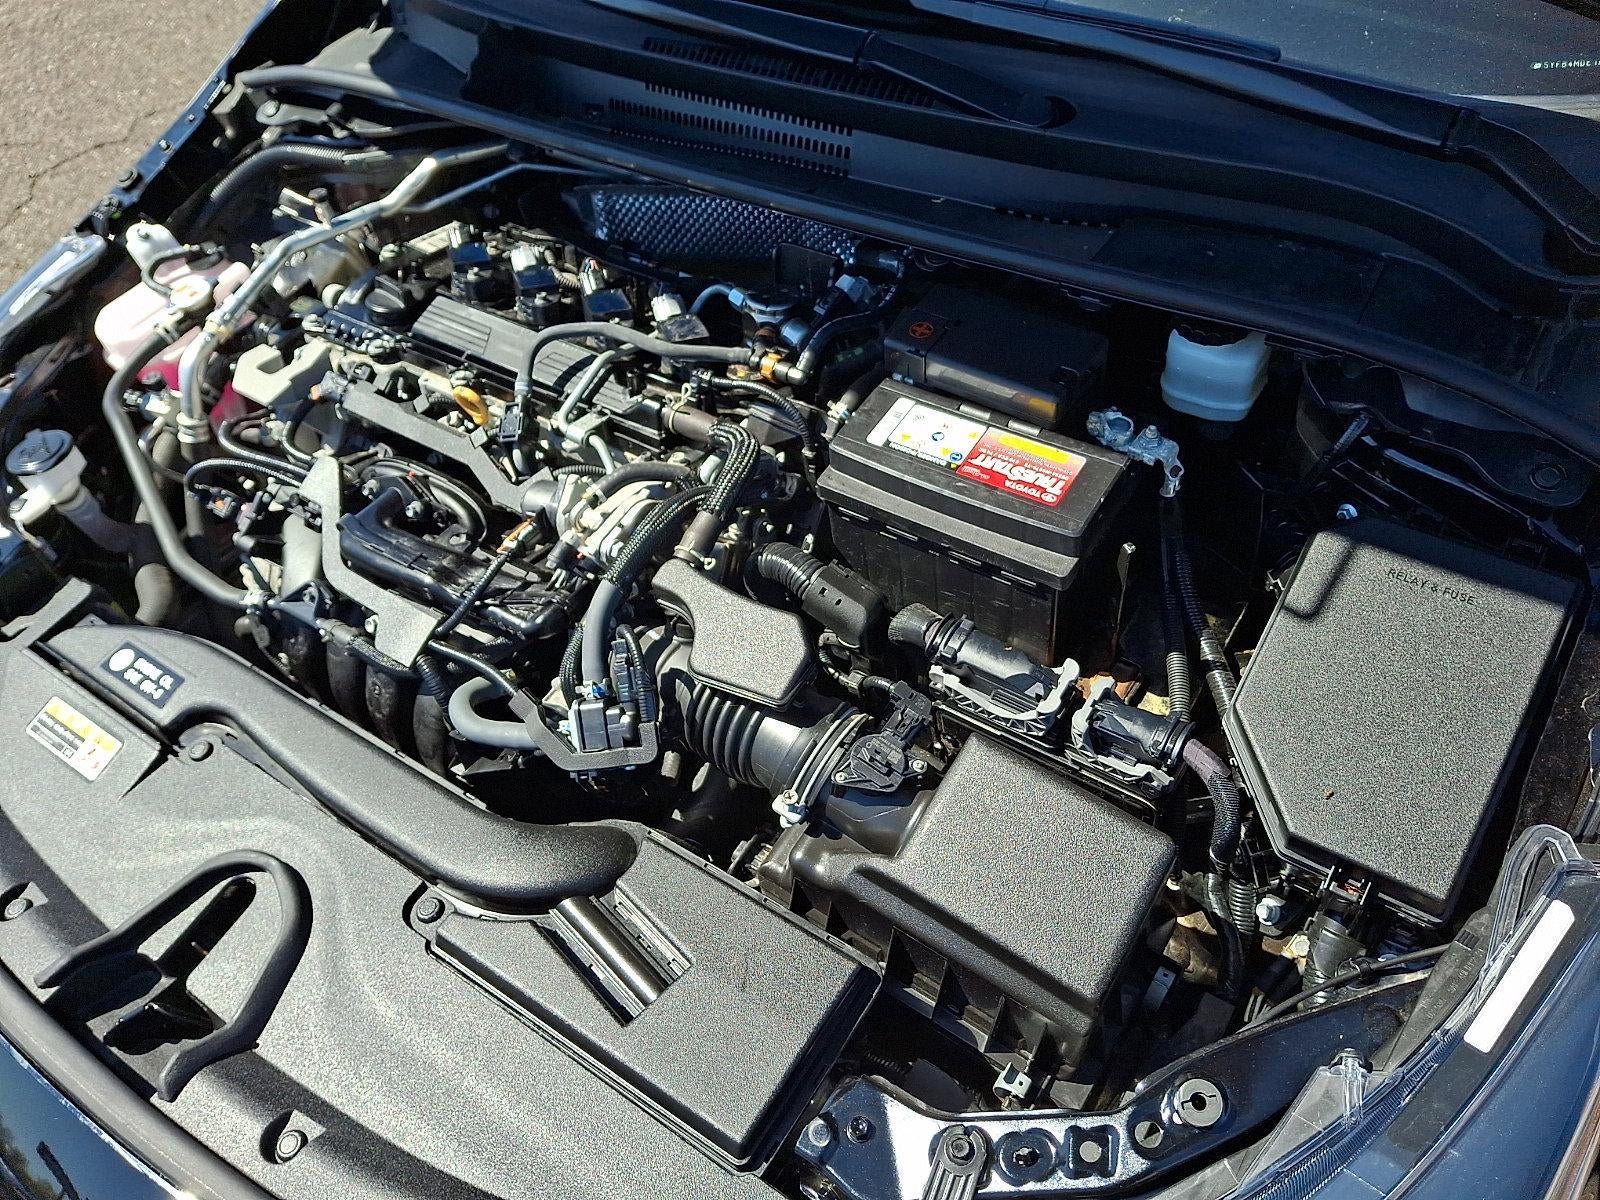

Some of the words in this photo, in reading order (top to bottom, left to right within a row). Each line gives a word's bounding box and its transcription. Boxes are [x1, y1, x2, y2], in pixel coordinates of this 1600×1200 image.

[1004, 479, 1042, 498] TOYOTA
[1387, 568, 1429, 589] RELAY
[1430, 583, 1440, 594] &
[1442, 587, 1476, 606] FUSE
